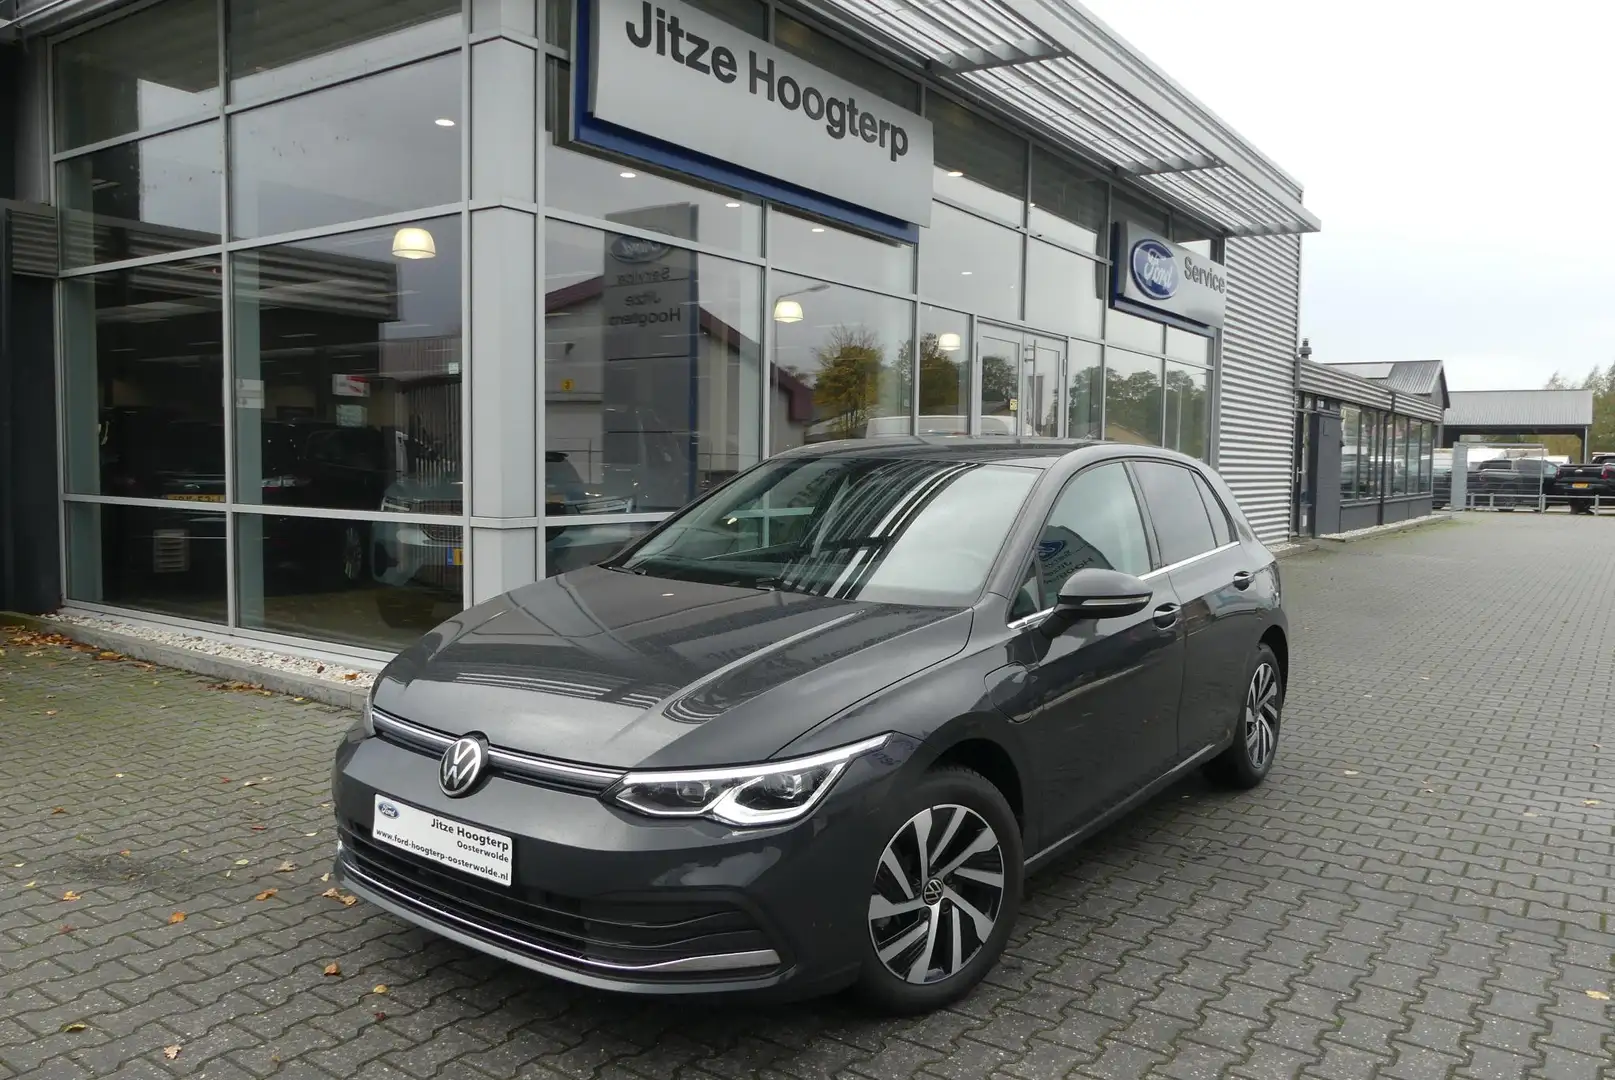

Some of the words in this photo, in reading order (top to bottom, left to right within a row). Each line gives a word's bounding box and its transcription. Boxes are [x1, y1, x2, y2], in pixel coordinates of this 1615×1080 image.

[626, 0, 738, 84] Jitze
[749, 50, 909, 161] Hoogterp
[1184, 256, 1225, 294] Service
[431, 818, 454, 834] Jitze
[457, 826, 509, 851] Hoogterp
[457, 840, 509, 863] Oosterwolde
[376, 828, 509, 880] www.ford-hoogterp-oosterwolde.nl
